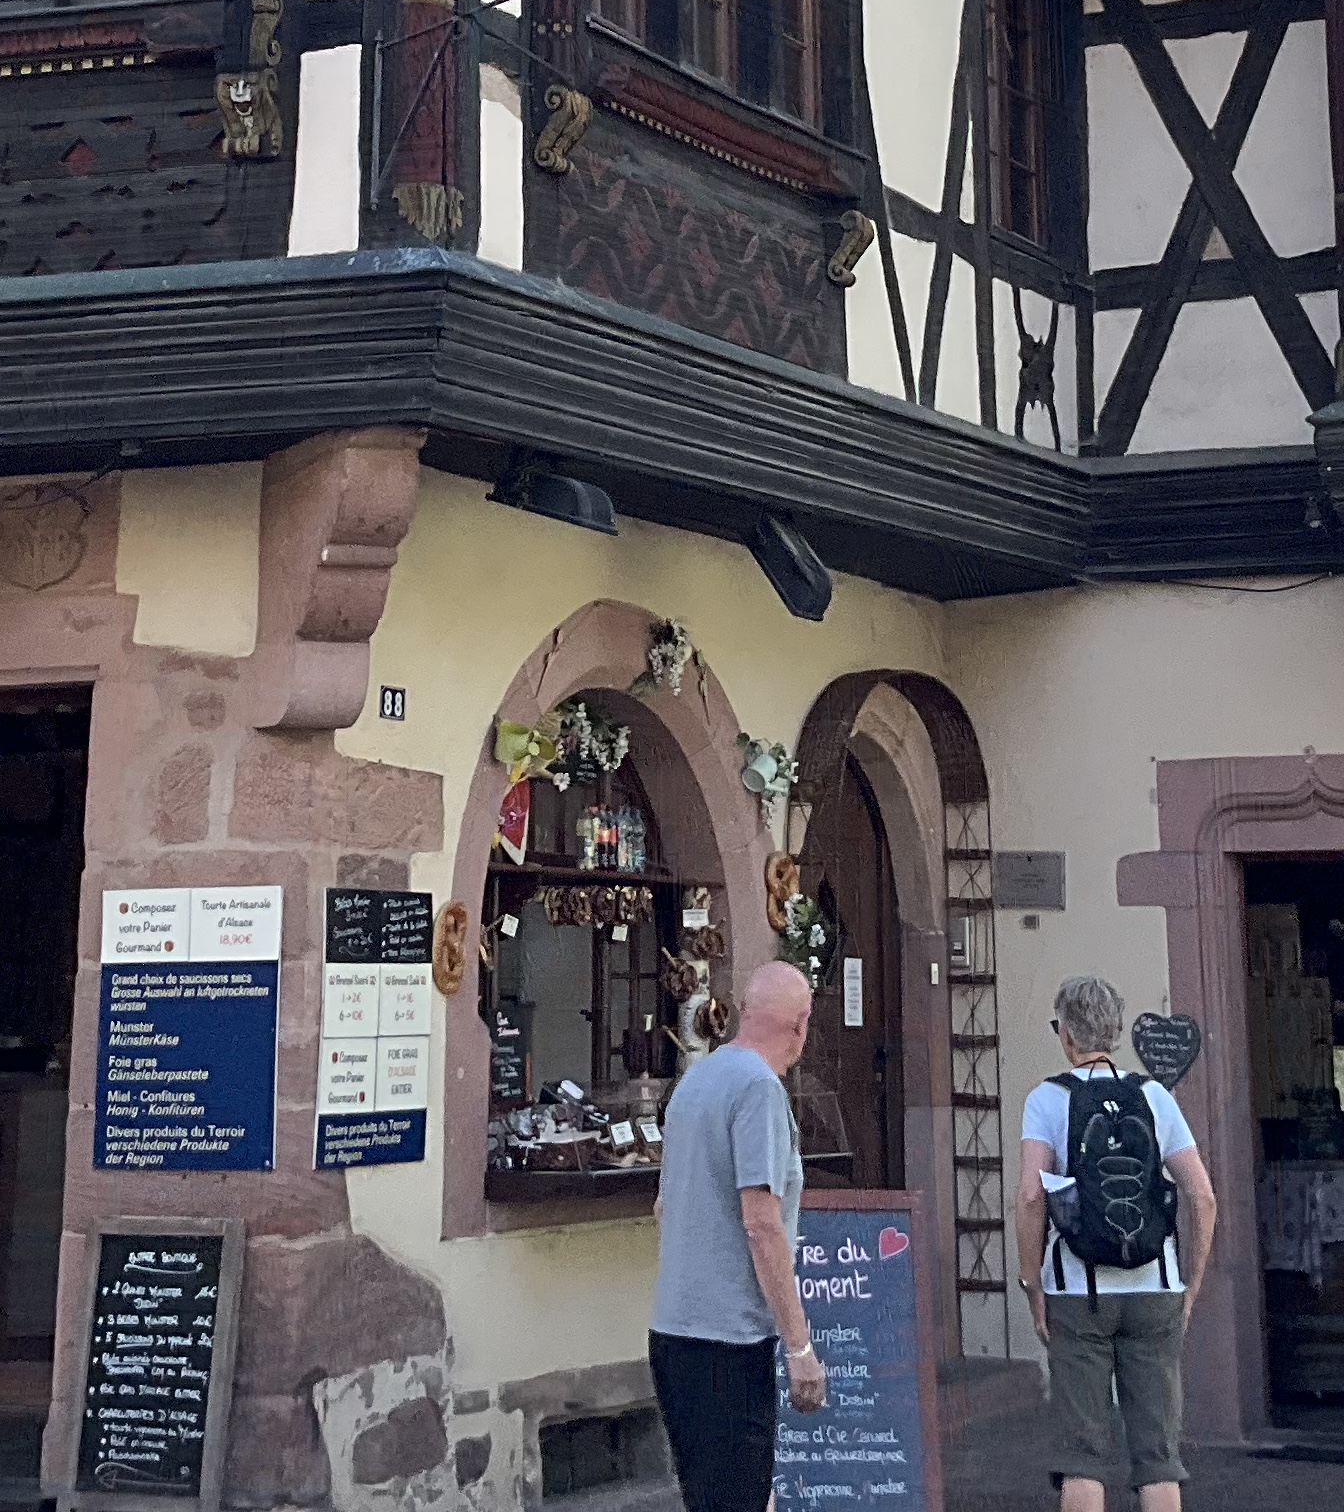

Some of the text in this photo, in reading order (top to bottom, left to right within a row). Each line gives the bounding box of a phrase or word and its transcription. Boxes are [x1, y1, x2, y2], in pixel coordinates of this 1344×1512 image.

[384, 690, 403, 717] 88
[131, 902, 177, 915] Composez
[201, 898, 271, 910] Tourte Artisanale
[119, 921, 172, 933] votre Panier
[218, 917, 253, 928] d'Alsace
[116, 940, 162, 953] Gourmand
[219, 934, 253, 946] 18,90€
[111, 973, 252, 985] Grand choix de saucissons secs
[111, 987, 141, 999] Grosse
[143, 986, 182, 998] Auswahl
[184, 988, 195, 997] an
[110, 1021, 154, 1033] Munster
[108, 1056, 158, 1070] Foie gras
[107, 1090, 131, 1102] Miel
[140, 1090, 196, 1102] Confitures
[106, 1104, 139, 1118] Honig
[148, 1104, 205, 1116] Konfitüren
[106, 1125, 246, 1140] Divers produits du Terroir
[105, 1139, 230, 1151] verschiedene Produkte
[105, 1152, 164, 1166] der Region
[837, 1237, 871, 1264] du
